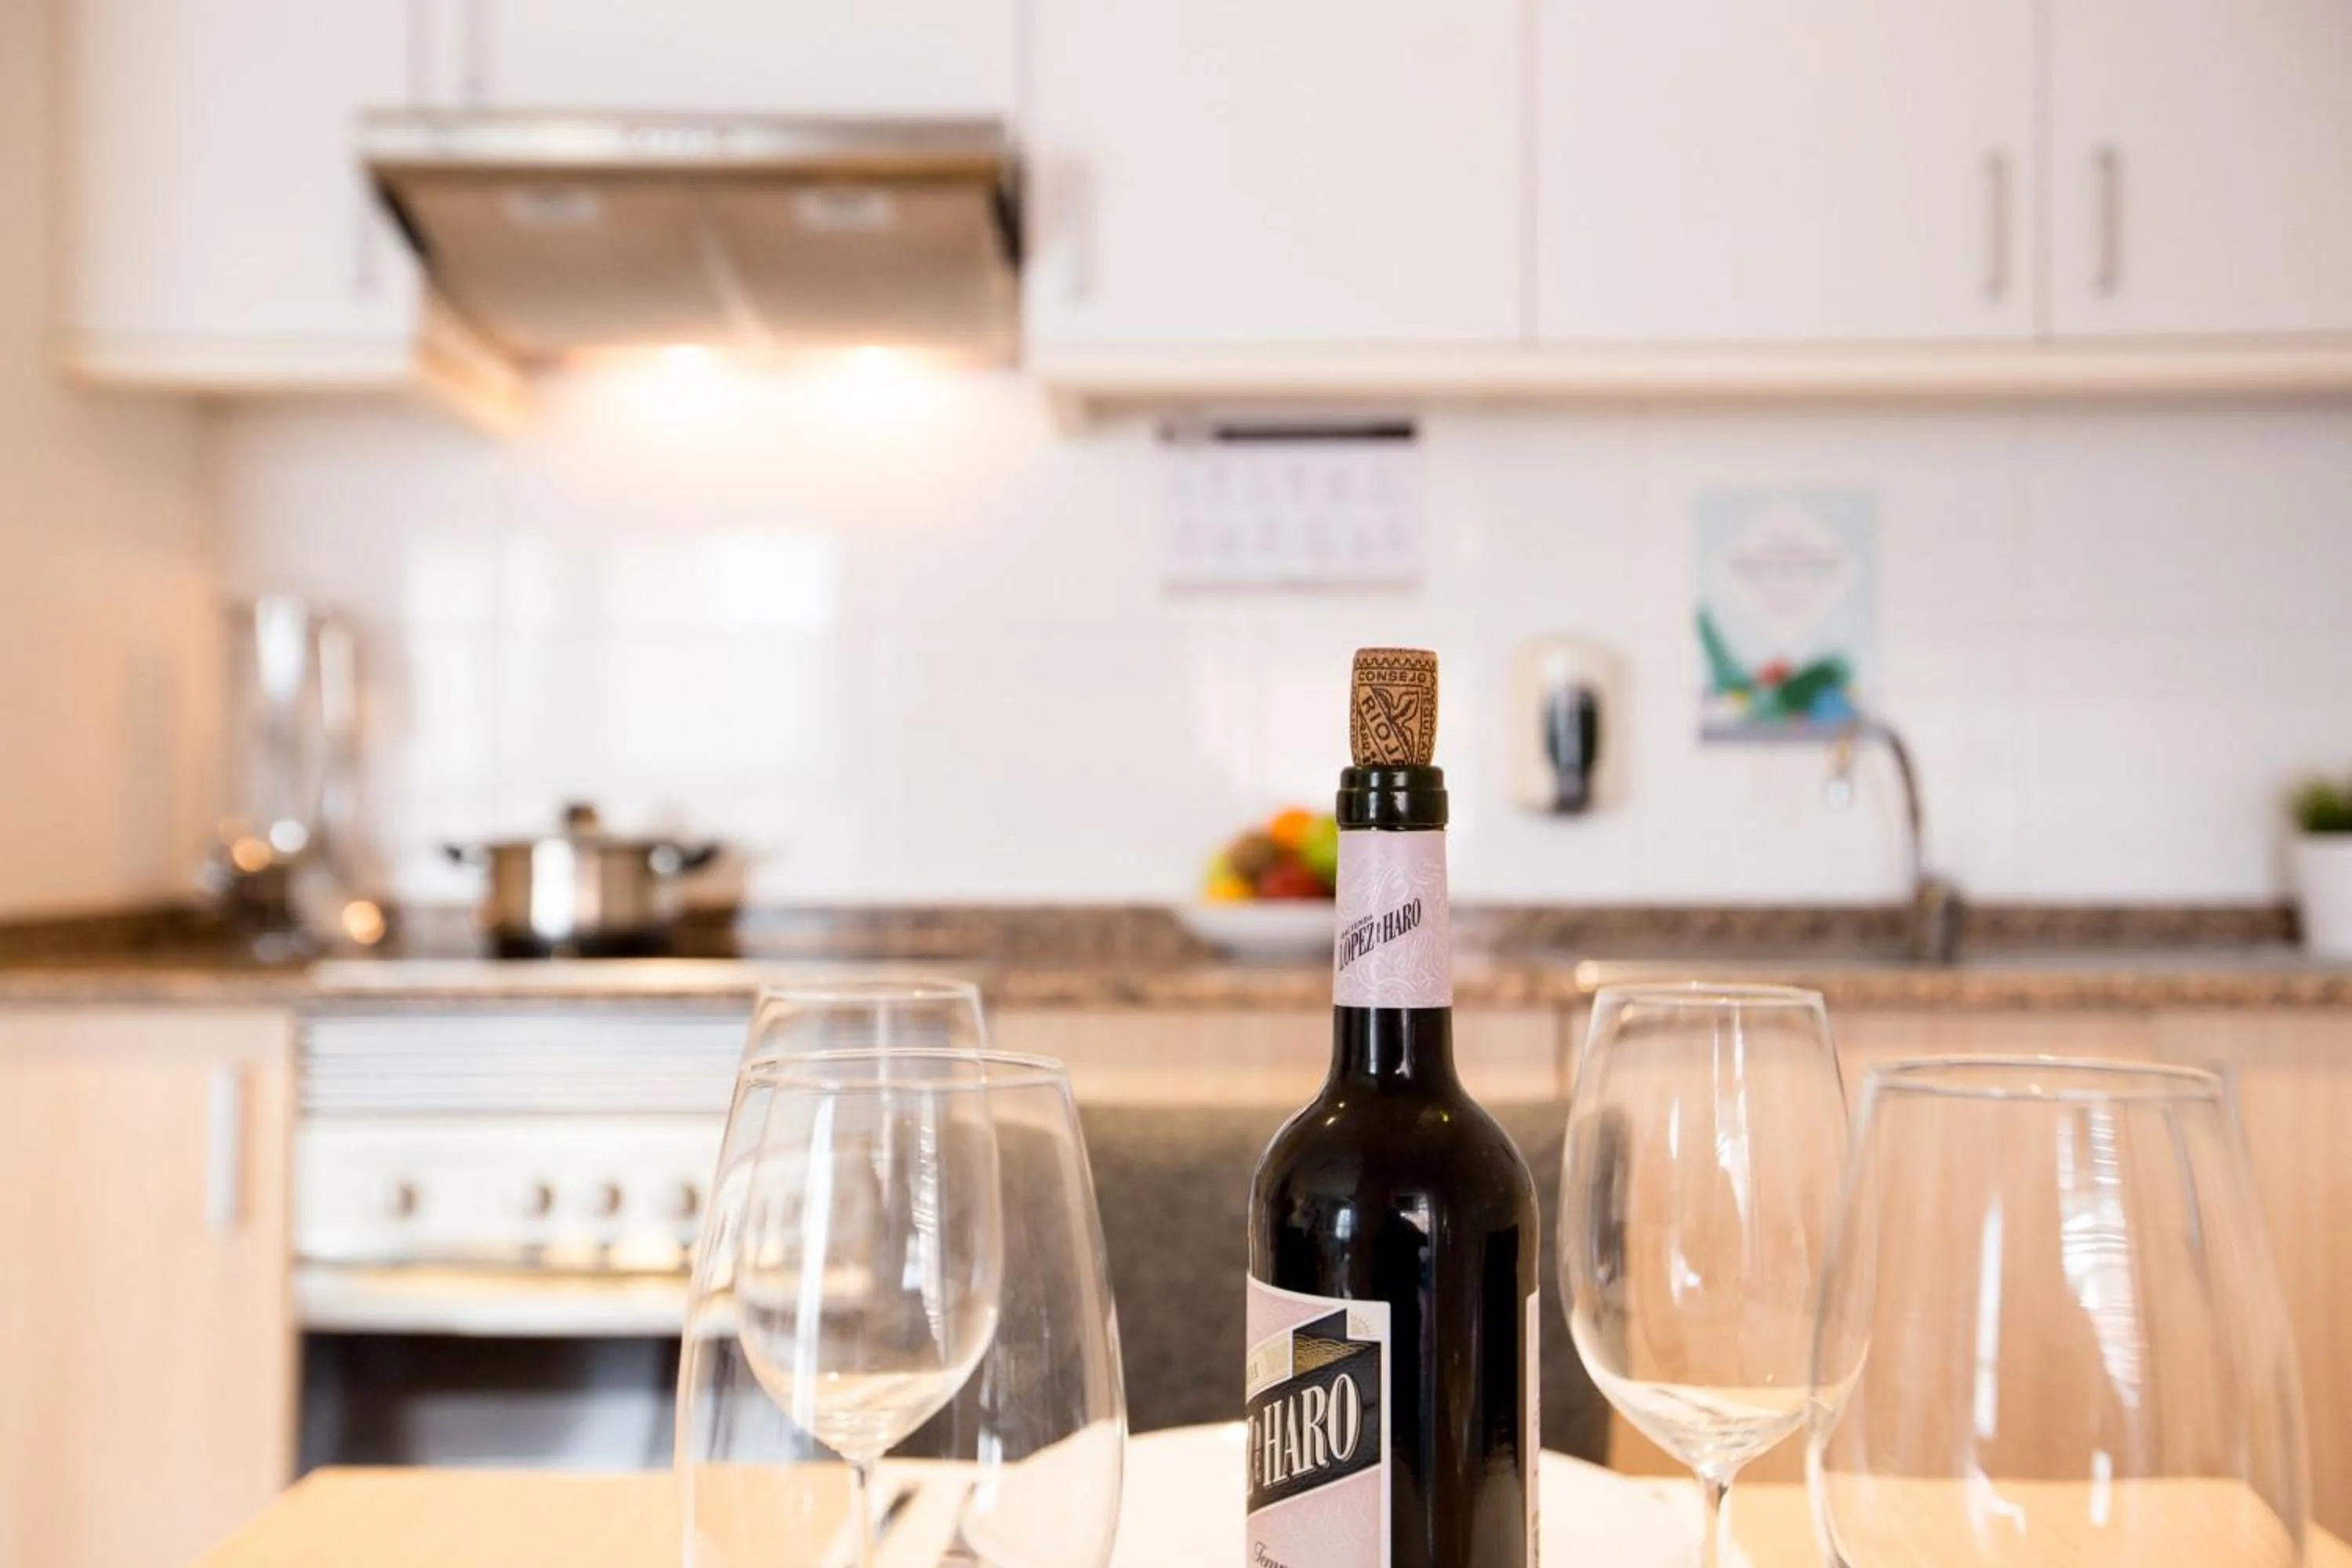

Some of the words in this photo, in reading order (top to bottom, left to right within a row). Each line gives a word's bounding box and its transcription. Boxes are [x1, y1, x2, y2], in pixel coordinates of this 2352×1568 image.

[1358, 670, 1427, 683] CONSEJO
[1383, 897, 1421, 943] HARO
[1263, 1373, 1363, 1490] HARO
